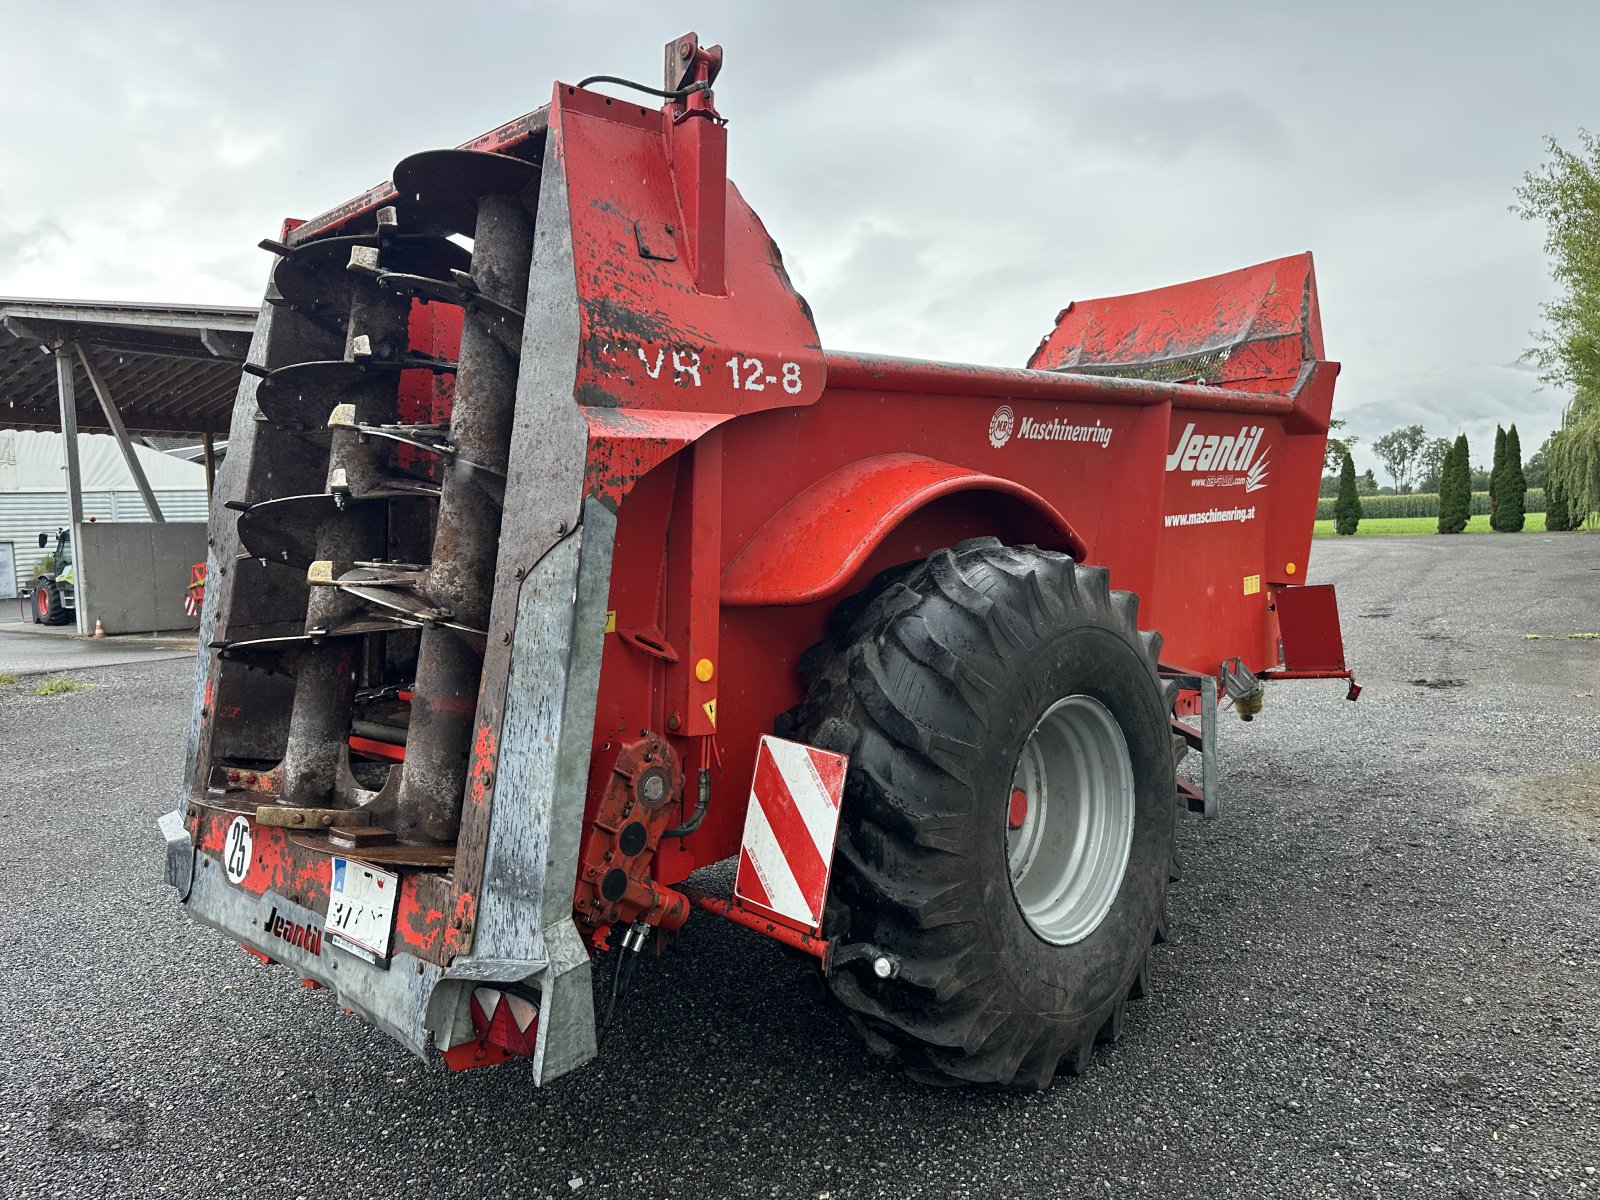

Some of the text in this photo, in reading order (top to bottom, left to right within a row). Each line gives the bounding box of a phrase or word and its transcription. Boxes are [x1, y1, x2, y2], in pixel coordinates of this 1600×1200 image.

[603, 344, 802, 394] VR 12-8
[1017, 416, 1113, 449] Maschinenring
[1165, 422, 1265, 471] Jeantil
[1164, 506, 1256, 528] www.maschinenring.at
[228, 821, 249, 878] 25
[264, 906, 323, 957] Jeantil
